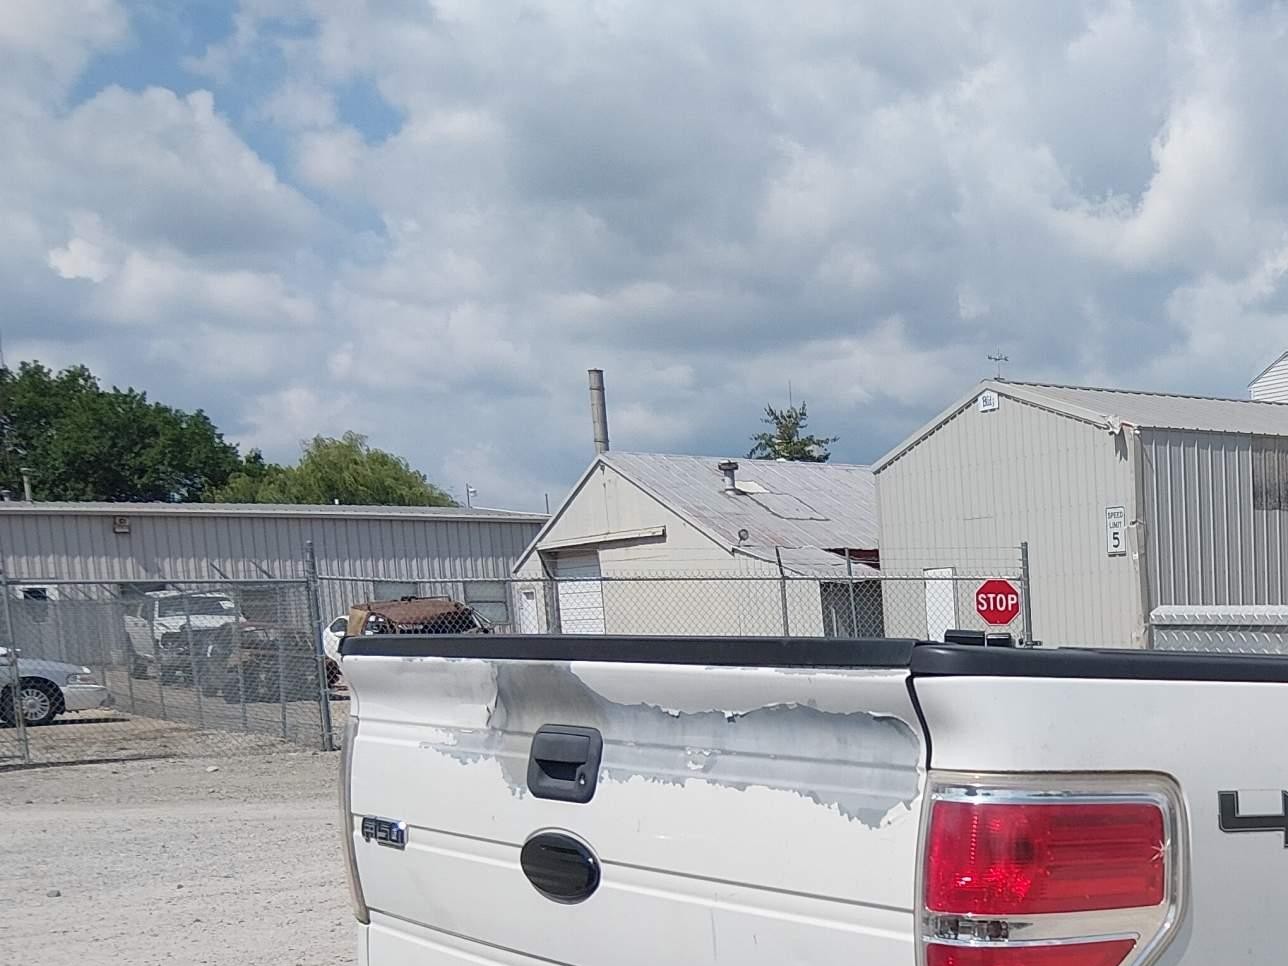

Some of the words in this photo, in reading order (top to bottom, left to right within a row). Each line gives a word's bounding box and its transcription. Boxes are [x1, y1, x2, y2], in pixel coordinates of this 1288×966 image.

[1107, 511, 1123, 519] SPEED
[1112, 531, 1120, 548] 5
[978, 593, 1017, 611] STOP
